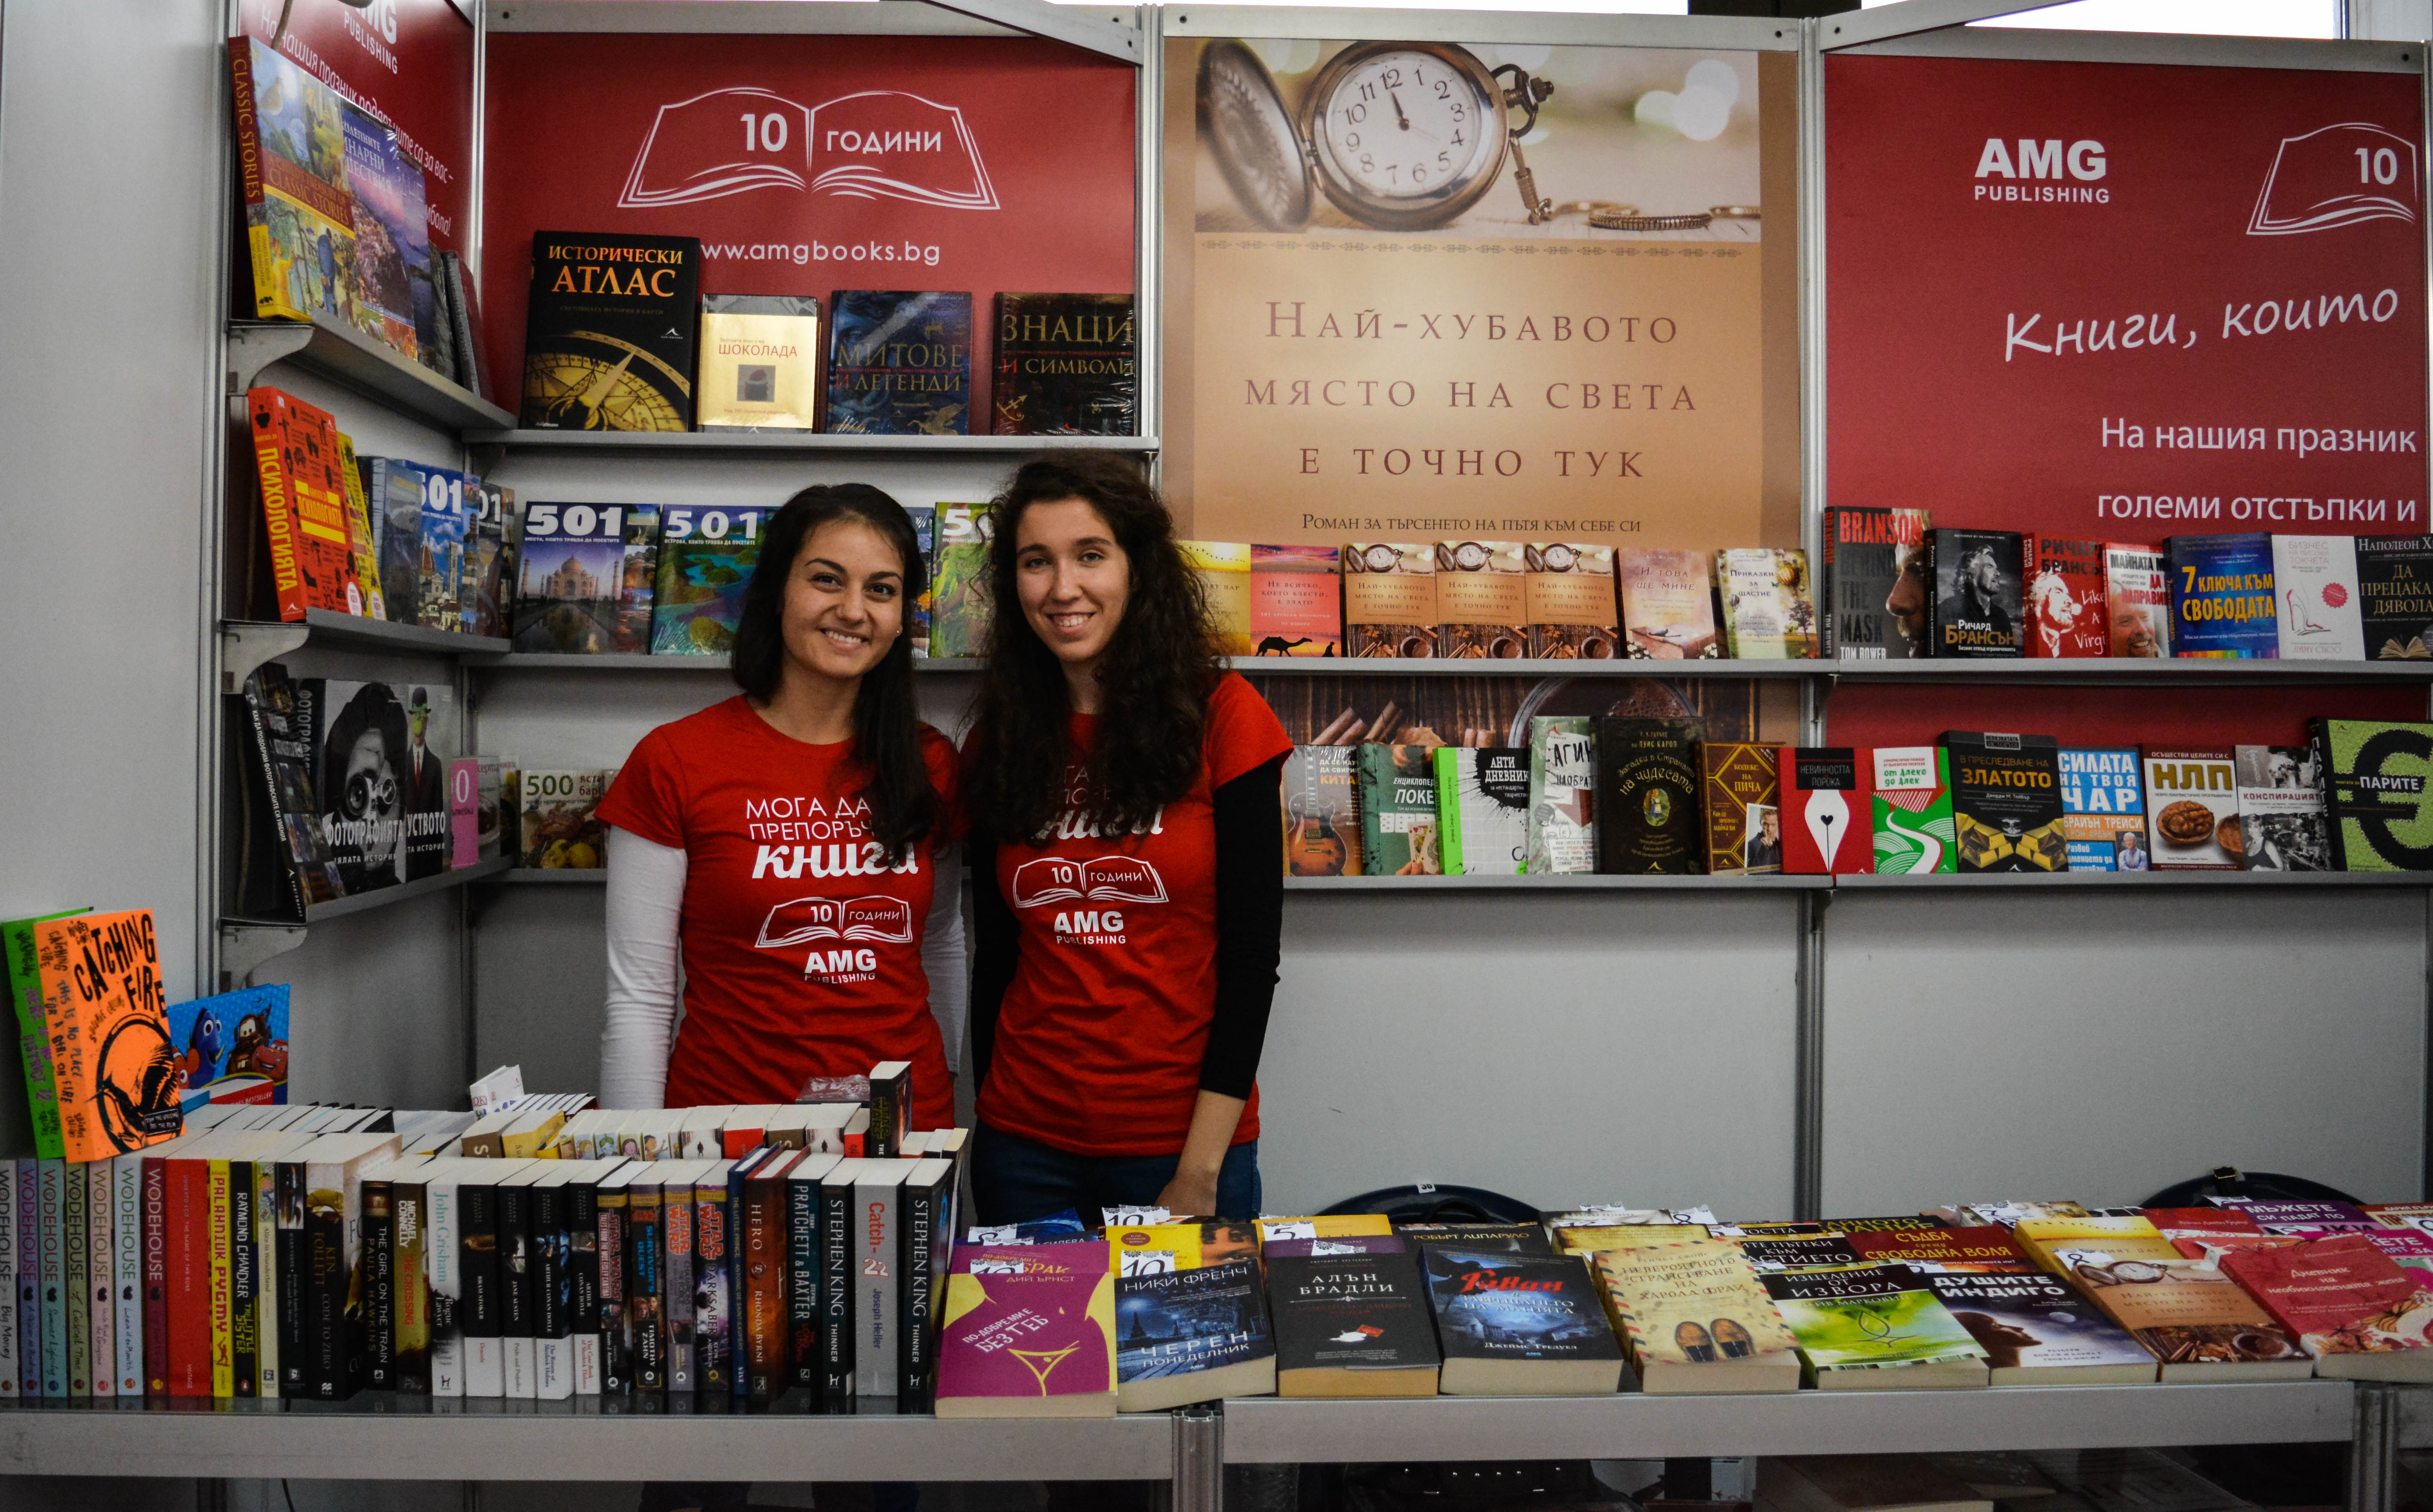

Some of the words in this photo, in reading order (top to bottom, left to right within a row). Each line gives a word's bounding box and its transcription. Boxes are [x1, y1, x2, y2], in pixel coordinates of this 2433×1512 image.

[344, 11, 398, 74] PUBLISHING
[1379, 67, 1404, 92] 12
[1412, 67, 1425, 87] 1
[233, 58, 252, 126] CLASSIC
[1358, 83, 1378, 104] 11
[1434, 80, 1452, 100] 2
[1343, 103, 1367, 125] 10
[1450, 102, 1465, 123] 3
[740, 113, 787, 152] 10
[826, 131, 942, 154] ГОДИНИ
[1345, 132, 1361, 153] 9
[1450, 129, 1465, 147] 4
[241, 129, 260, 199] STORIES
[1358, 153, 1376, 174] 8
[1437, 151, 1452, 172] 5
[1975, 138, 2107, 181] AMG
[2354, 147, 2398, 185] 10
[1386, 165, 1400, 186] 7
[1412, 162, 1428, 183] 6
[1974, 184, 2110, 204] PUBLISHING
[549, 245, 683, 265] ИСТОРИЧЕСКИ
[552, 266, 676, 297] АТЛАС
[1003, 315, 1134, 347] ЗНАЦИ
[2004, 312, 2197, 362] Книги,
[2222, 288, 2398, 340] които
[719, 344, 798, 358] ШОКОЛАДА
[837, 344, 962, 368] МИТОВЕ
[1003, 359, 1018, 374] И
[1025, 359, 1134, 375] СИМВОЛИ
[835, 374, 850, 390] И
[855, 373, 961, 393] ЛЕГЕНДИ
[1244, 379, 1417, 408] МЯСТО
[1449, 382, 1514, 409] НА
[1547, 383, 1696, 411] СВЕТА
[2101, 417, 2144, 450] На
[2156, 423, 2265, 451] нашия
[2277, 425, 2417, 460] празник
[1299, 448, 1320, 475] Е
[1353, 448, 1522, 477] ТОЧНО
[1554, 450, 1644, 478] ТУК
[2098, 493, 2220, 521] големи
[2230, 494, 2386, 523] отстъпки
[2397, 498, 2416, 522] и
[258, 447, 298, 592] ПСИХОЛОГИЯТА
[526, 506, 622, 536] 501
[665, 511, 758, 539] 501
[1364, 518, 1382, 531] ЗА
[1387, 518, 1471, 533] ТЪРСЕНЕТО
[1475, 518, 1497, 532] НА
[1502, 518, 1540, 533] ПЪТЯ
[1544, 519, 1576, 533] КЪМ
[1580, 519, 1614, 533] СЕБЕ
[1619, 519, 1641, 533] СИ
[1839, 511, 1923, 546] BRANSON
[1659, 569, 1688, 577] ТОВА
[2182, 566, 2196, 593] 7
[2199, 575, 2242, 592] КЛЮЧА
[2245, 573, 2273, 590] КЪМ
[1662, 583, 1695, 591] МИНЕ
[2182, 596, 2275, 623] СВОБОДАТА
[1945, 625, 2016, 645] БРАНСЪН
[1958, 620, 1991, 632] РИЧАРД
[1490, 757, 1515, 769] АНТИ
[1800, 765, 1851, 775] НЕВИННОСТТА
[2057, 753, 2135, 773] СИЛАТА
[526, 776, 574, 796] 500
[1734, 782, 1761, 792] ПИЧА
[1812, 776, 1840, 786] ПОРОКА
[1962, 769, 2052, 789] ЗЛАТОТО
[2060, 774, 2081, 786] НА
[2091, 775, 2136, 786] ТВОЯ
[2153, 764, 2233, 790] НЛП
[2360, 776, 2420, 790] ПАРИТЕ
[746, 797, 827, 819] МОГА
[835, 796, 872, 819] ДА
[2061, 789, 2137, 811] ЧАР
[326, 819, 404, 847] ФОТОГРАФИЯТА
[2064, 817, 2101, 828] БРАЙЪН
[2106, 818, 2142, 829] ТРЕЙСИ
[752, 842, 919, 879] книги
[1051, 866, 1073, 884] 10
[1090, 871, 1143, 882] ГОДИНИ
[810, 905, 833, 923] 10
[849, 911, 900, 922] ГОДИНИ
[1054, 911, 1124, 934] AMG
[1056, 934, 1126, 945] PUBLISHING
[74, 914, 156, 1003] CATCHING
[804, 949, 876, 974] AMG
[805, 972, 876, 984] PUBLISHING
[123, 966, 167, 1018] FIRE
[214, 1178, 226, 1259] PALAHNIUK
[237, 1193, 247, 1241] RAYMOND
[2245, 1205, 2337, 1214] МЪЖЕТЕ
[22, 1169, 38, 1281] WODEHOUSE
[44, 1169, 58, 1282] WODEHOUSE
[69, 1168, 83, 1280] WODEHOUSE
[94, 1169, 107, 1282] WODEHOUSE
[121, 1168, 135, 1279] WODEHOUSE
[147, 1168, 162, 1280] WODEHOUSE
[752, 1205, 762, 1250] HERO
[794, 1185, 809, 1257] PRATCHETT
[869, 1202, 885, 1253] Catch-
[830, 1200, 844, 1272] STEPHEN
[1895, 1230, 1953, 1242] СЪДБА
[1865, 1247, 1963, 1260] СВОБОДНА
[1965, 1246, 2012, 1257] ВОЛЯ
[237, 1245, 249, 1297] CHANDLER
[378, 1253, 387, 1279] GIRL
[863, 1258, 888, 1277] 22
[1785, 1269, 1884, 1282] ИЗЦЕЛЕНИЕ
[2290, 1266, 2350, 1279] Дневник
[1125, 1276, 1178, 1291] НИКИ
[1183, 1267, 1247, 1284] ФРЕНЧ
[1312, 1273, 1377, 1283] АЛЪН
[1934, 1276, 2053, 1287] ДУШИТЕ
[2267, 1282, 2372, 1294] необикновената
[2377, 1277, 2407, 1286] жена
[215, 1267, 227, 1333] PYGMY
[378, 1282, 387, 1299] ON
[795, 1271, 810, 1319] BAXTER
[830, 1276, 844, 1316] KING
[1299, 1284, 1395, 1295] БРАДЛИ
[1792, 1282, 1902, 1297] ИЗВОРА
[1940, 1287, 2065, 1297] ИНДИГО
[378, 1304, 387, 1325] THE
[378, 1328, 387, 1363] TRAIN
[1141, 1331, 1248, 1356] ЧЕРЕН
[1143, 1344, 1249, 1368] ПОНЕДЕЛНИК
